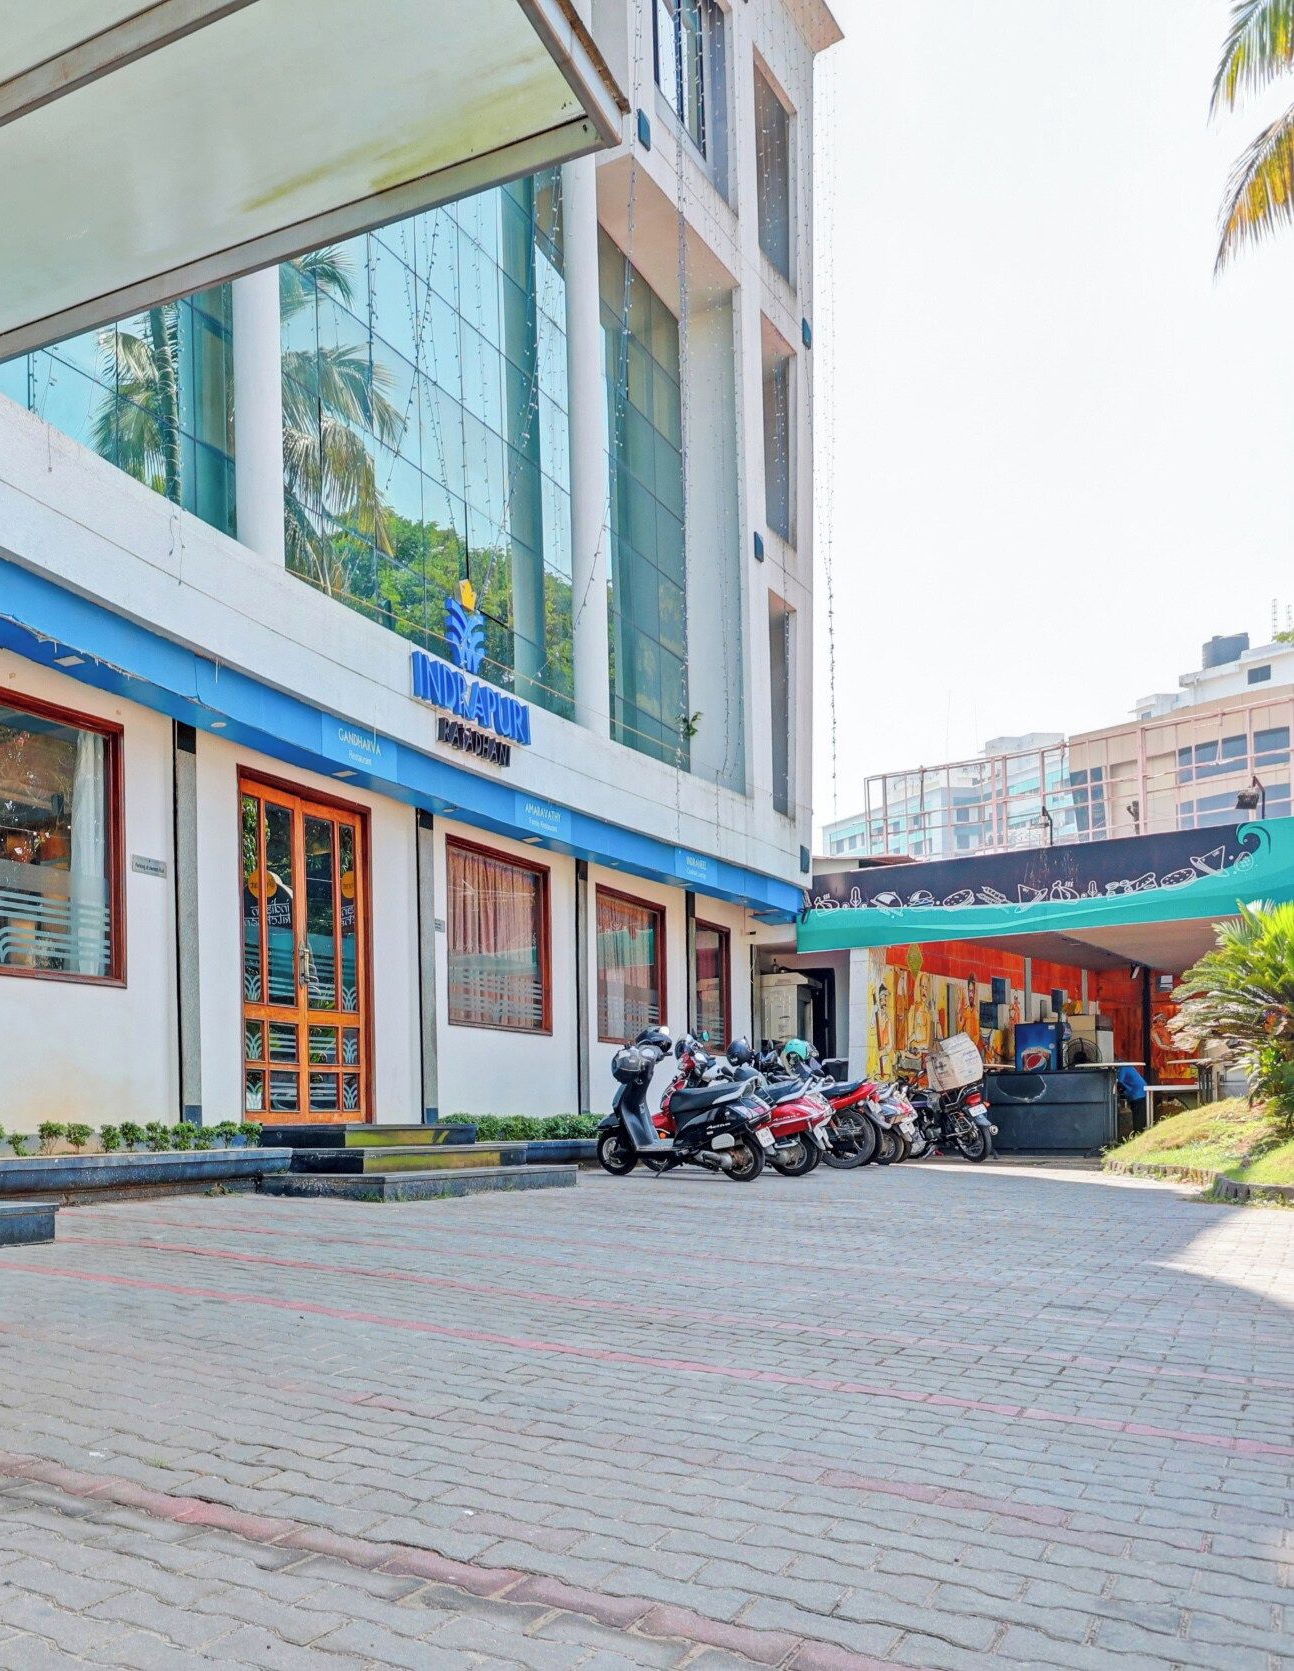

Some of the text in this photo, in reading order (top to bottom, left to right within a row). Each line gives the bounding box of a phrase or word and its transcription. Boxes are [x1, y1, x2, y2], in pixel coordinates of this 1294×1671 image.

[412, 651, 531, 745] INDRAPURI
[338, 727, 382, 757] GANDHARVA
[438, 717, 512, 767] RAJADHANI
